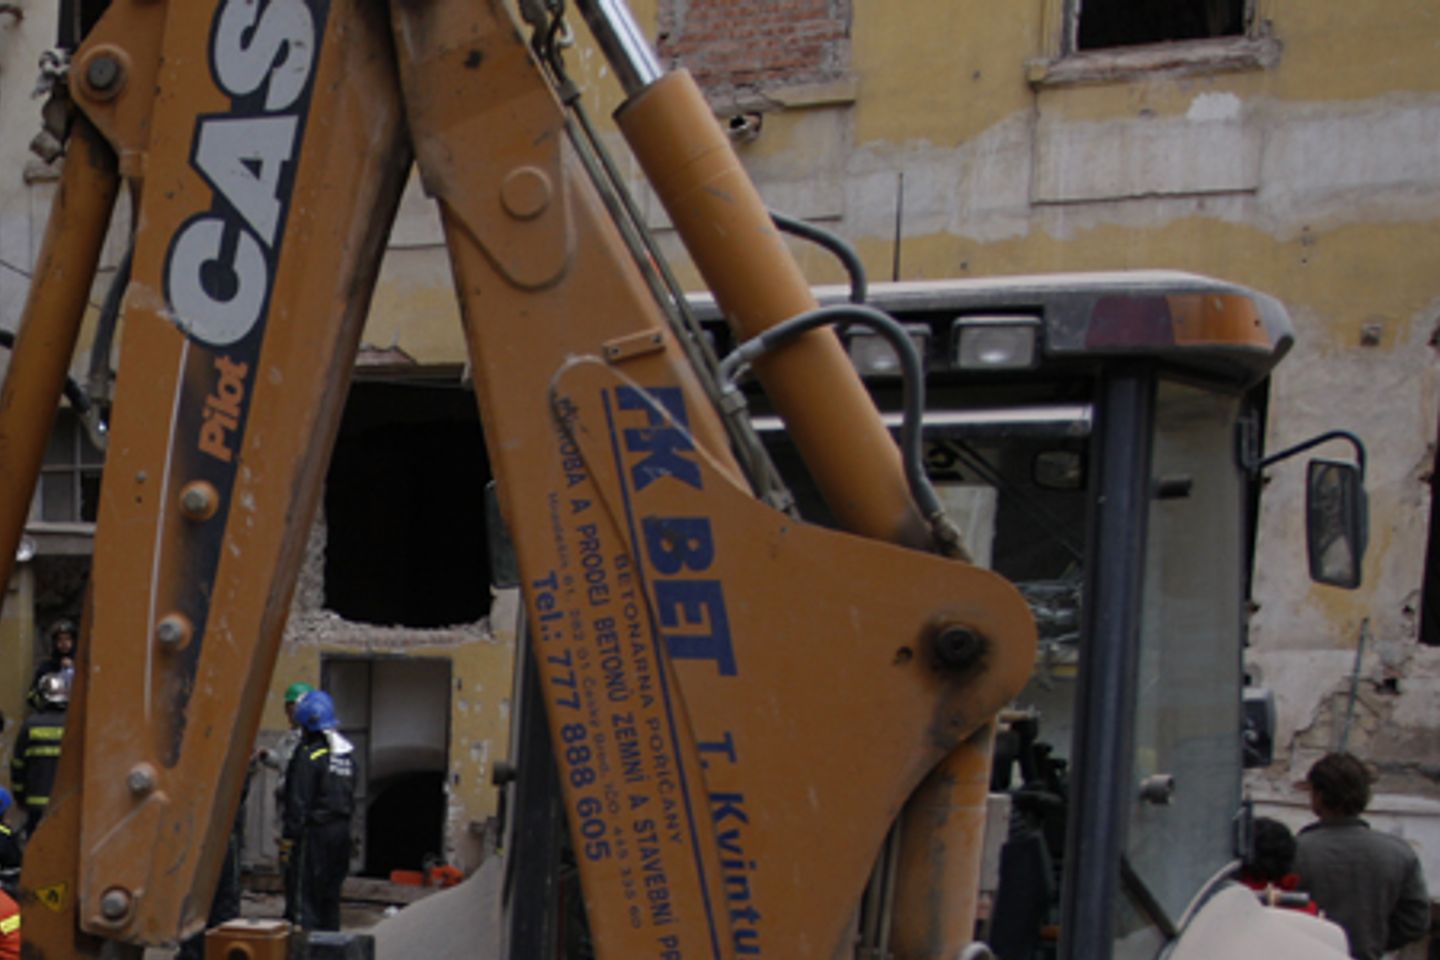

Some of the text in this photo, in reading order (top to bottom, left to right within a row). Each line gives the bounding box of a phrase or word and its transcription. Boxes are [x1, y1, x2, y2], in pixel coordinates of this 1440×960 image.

[197, 353, 250, 463] Pilot
[571, 499, 589, 514] A
[577, 523, 610, 606] PRODEJ
[593, 616, 630, 702] BETONŮ
[641, 517, 737, 677] BET
[697, 731, 736, 769] T.
[532, 570, 611, 862] Tel.: 777 888 605
[612, 712, 647, 783] ZEMNÍ
[629, 794, 648, 809] A
[634, 819, 673, 925] STAVEBNÍ
